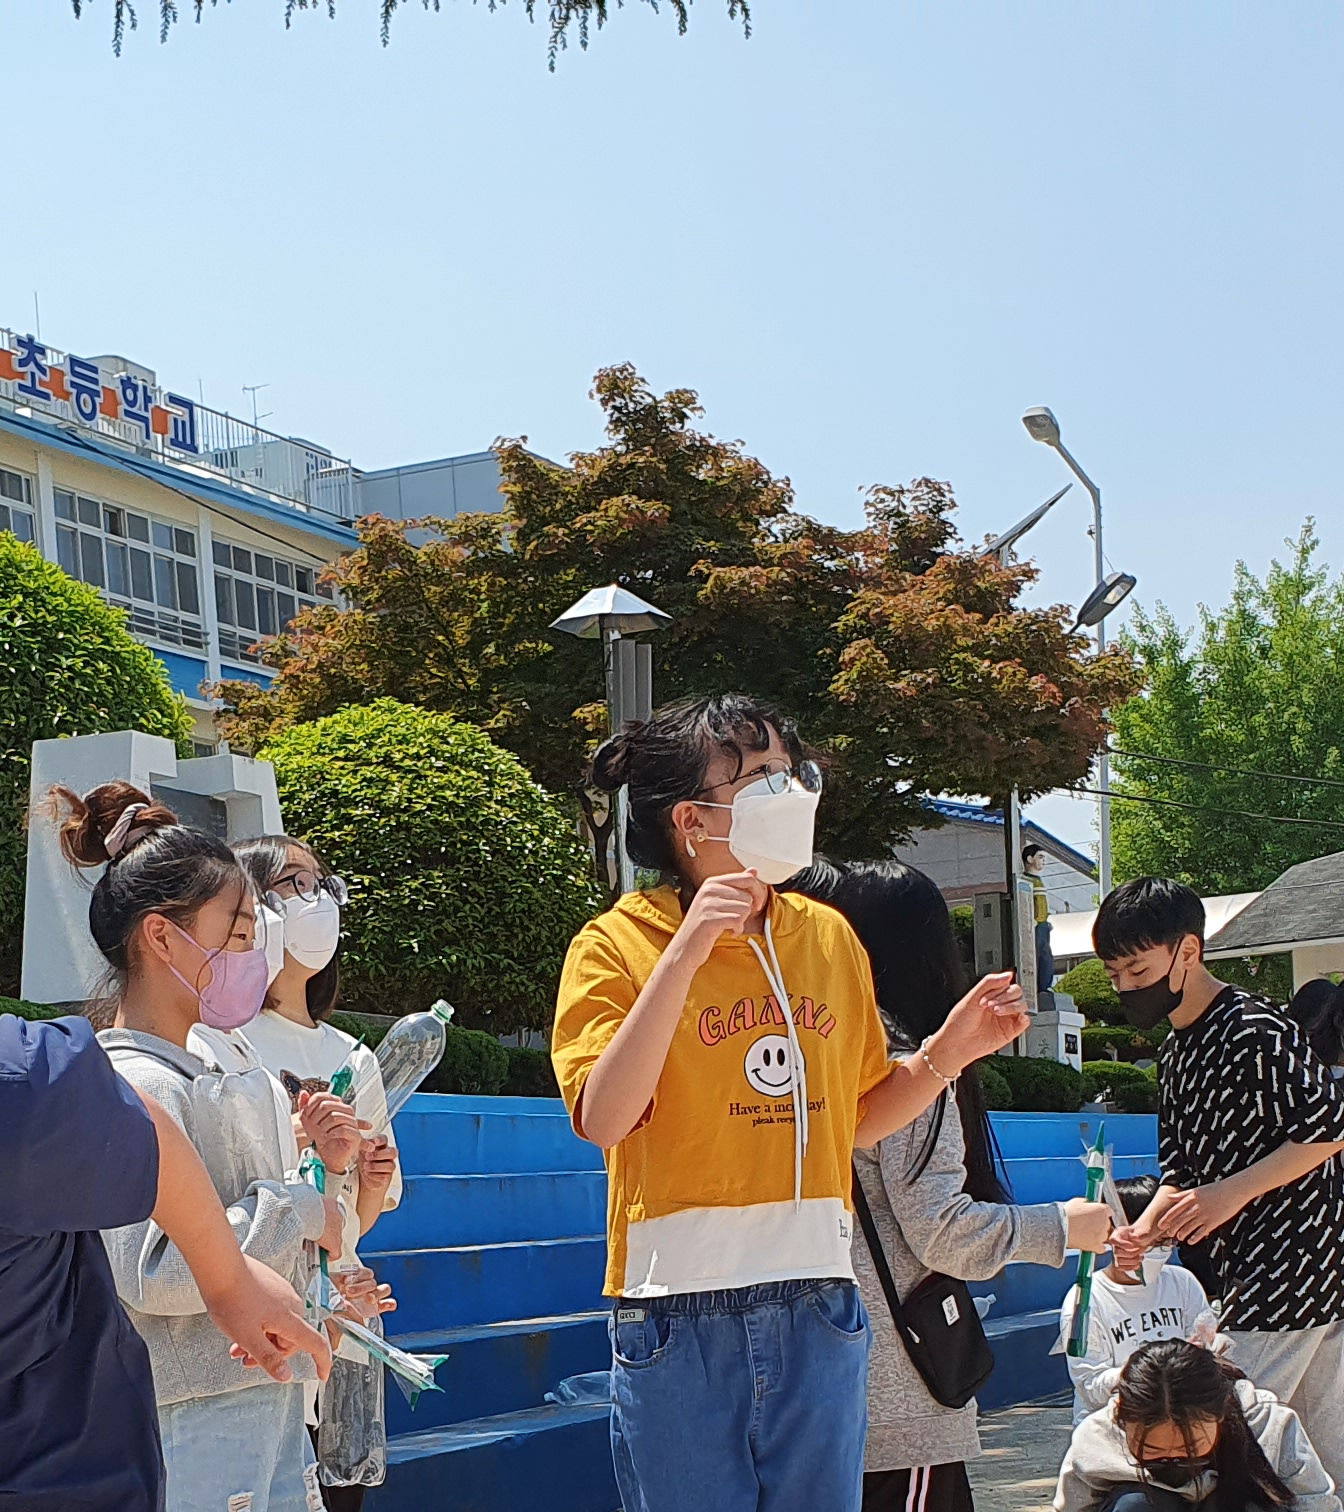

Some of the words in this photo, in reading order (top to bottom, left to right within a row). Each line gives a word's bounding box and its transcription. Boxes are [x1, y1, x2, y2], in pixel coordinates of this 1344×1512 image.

[698, 993, 837, 1046] GANNI
[729, 1102, 761, 1116] Have
[764, 1104, 771, 1113] a
[808, 1097, 826, 1112] ay!
[1111, 1318, 1136, 1344] WE
